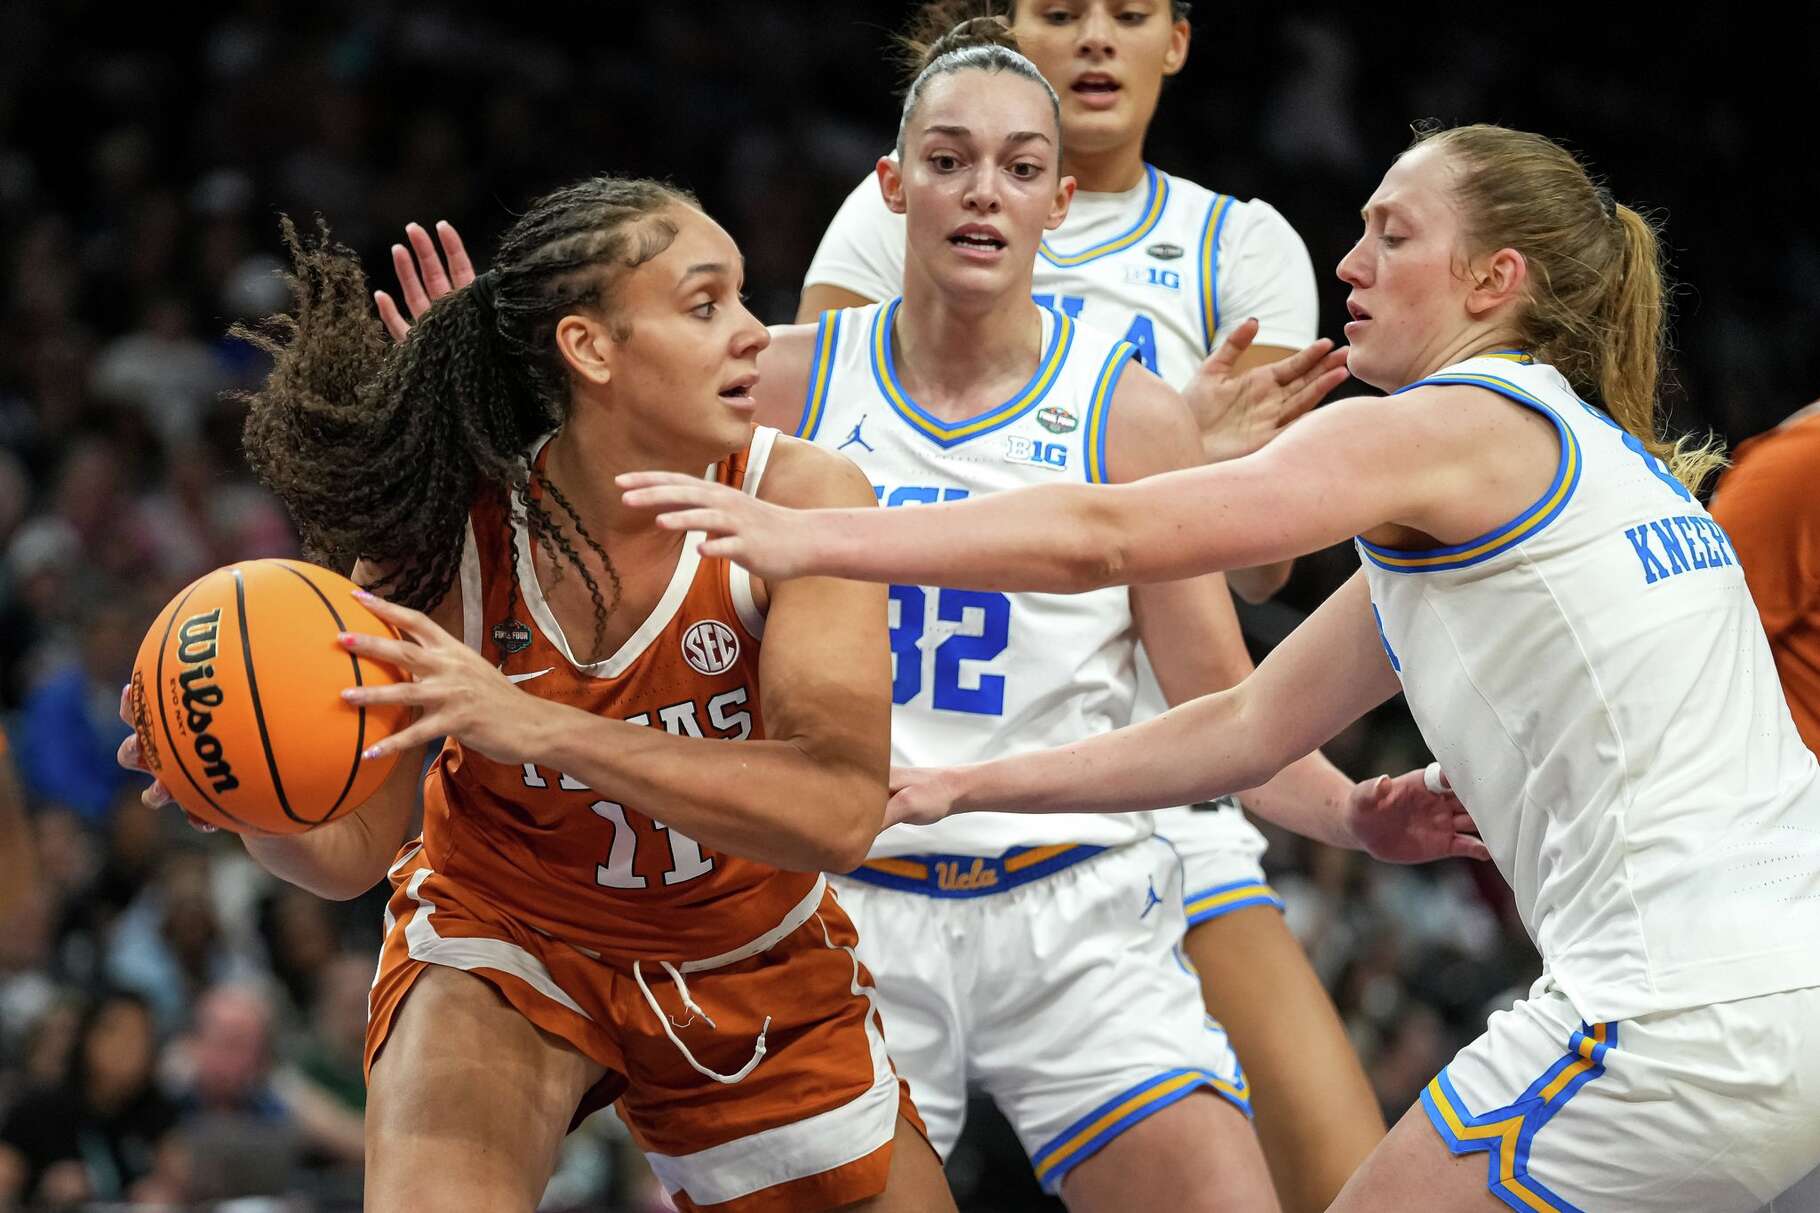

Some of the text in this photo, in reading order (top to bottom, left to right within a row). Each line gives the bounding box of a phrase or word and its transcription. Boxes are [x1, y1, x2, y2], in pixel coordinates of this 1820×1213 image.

[1624, 516, 1741, 584] KNEEP
[512, 631, 529, 640] FOUR
[684, 624, 736, 672] SEC
[888, 584, 1011, 716] 32
[177, 608, 239, 794] Wilson
[590, 800, 714, 889] 11
[935, 858, 998, 891] Ucla
